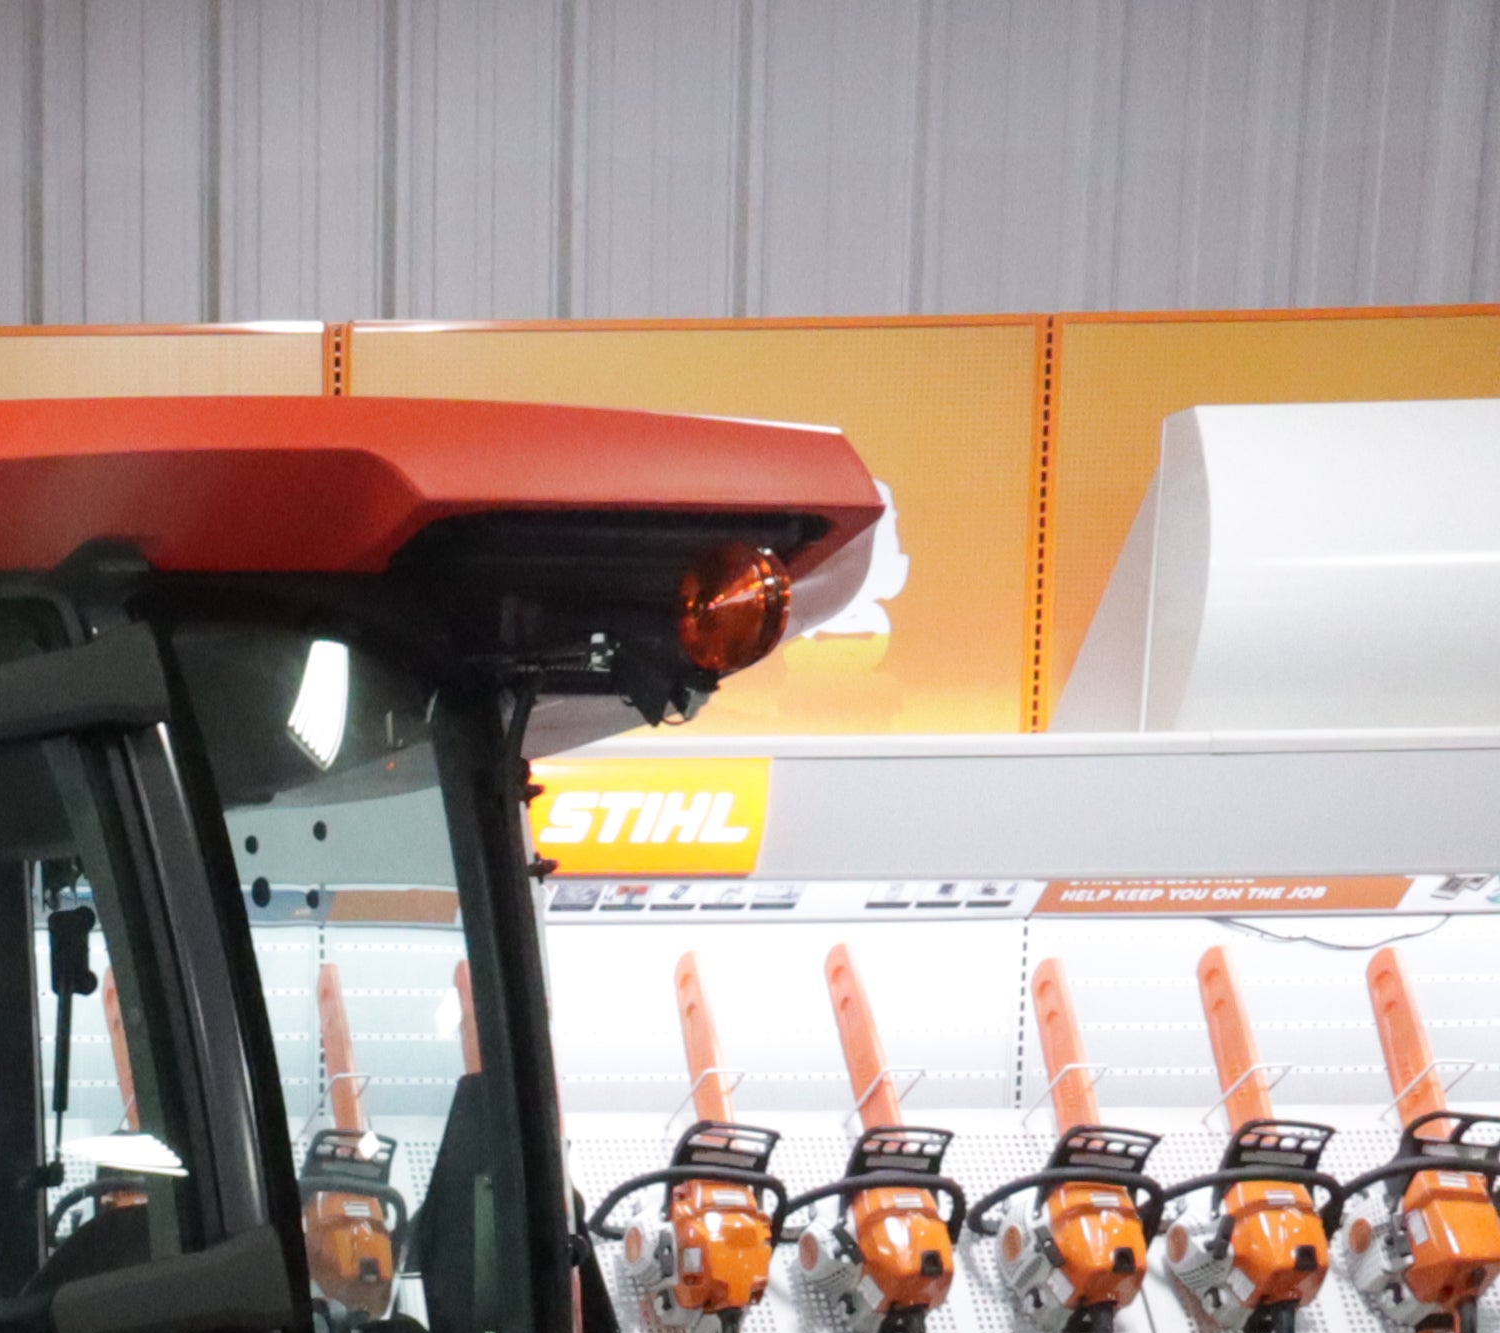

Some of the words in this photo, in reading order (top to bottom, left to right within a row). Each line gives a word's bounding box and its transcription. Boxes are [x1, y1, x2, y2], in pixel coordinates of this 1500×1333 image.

[538, 792, 750, 844] STIHL
[1060, 887, 1110, 903] HELP
[1113, 887, 1165, 902] KEEP
[1169, 886, 1209, 900] YOU
[1213, 886, 1243, 900] ON
[1247, 885, 1288, 899] THE
[1290, 884, 1327, 899] JOB
